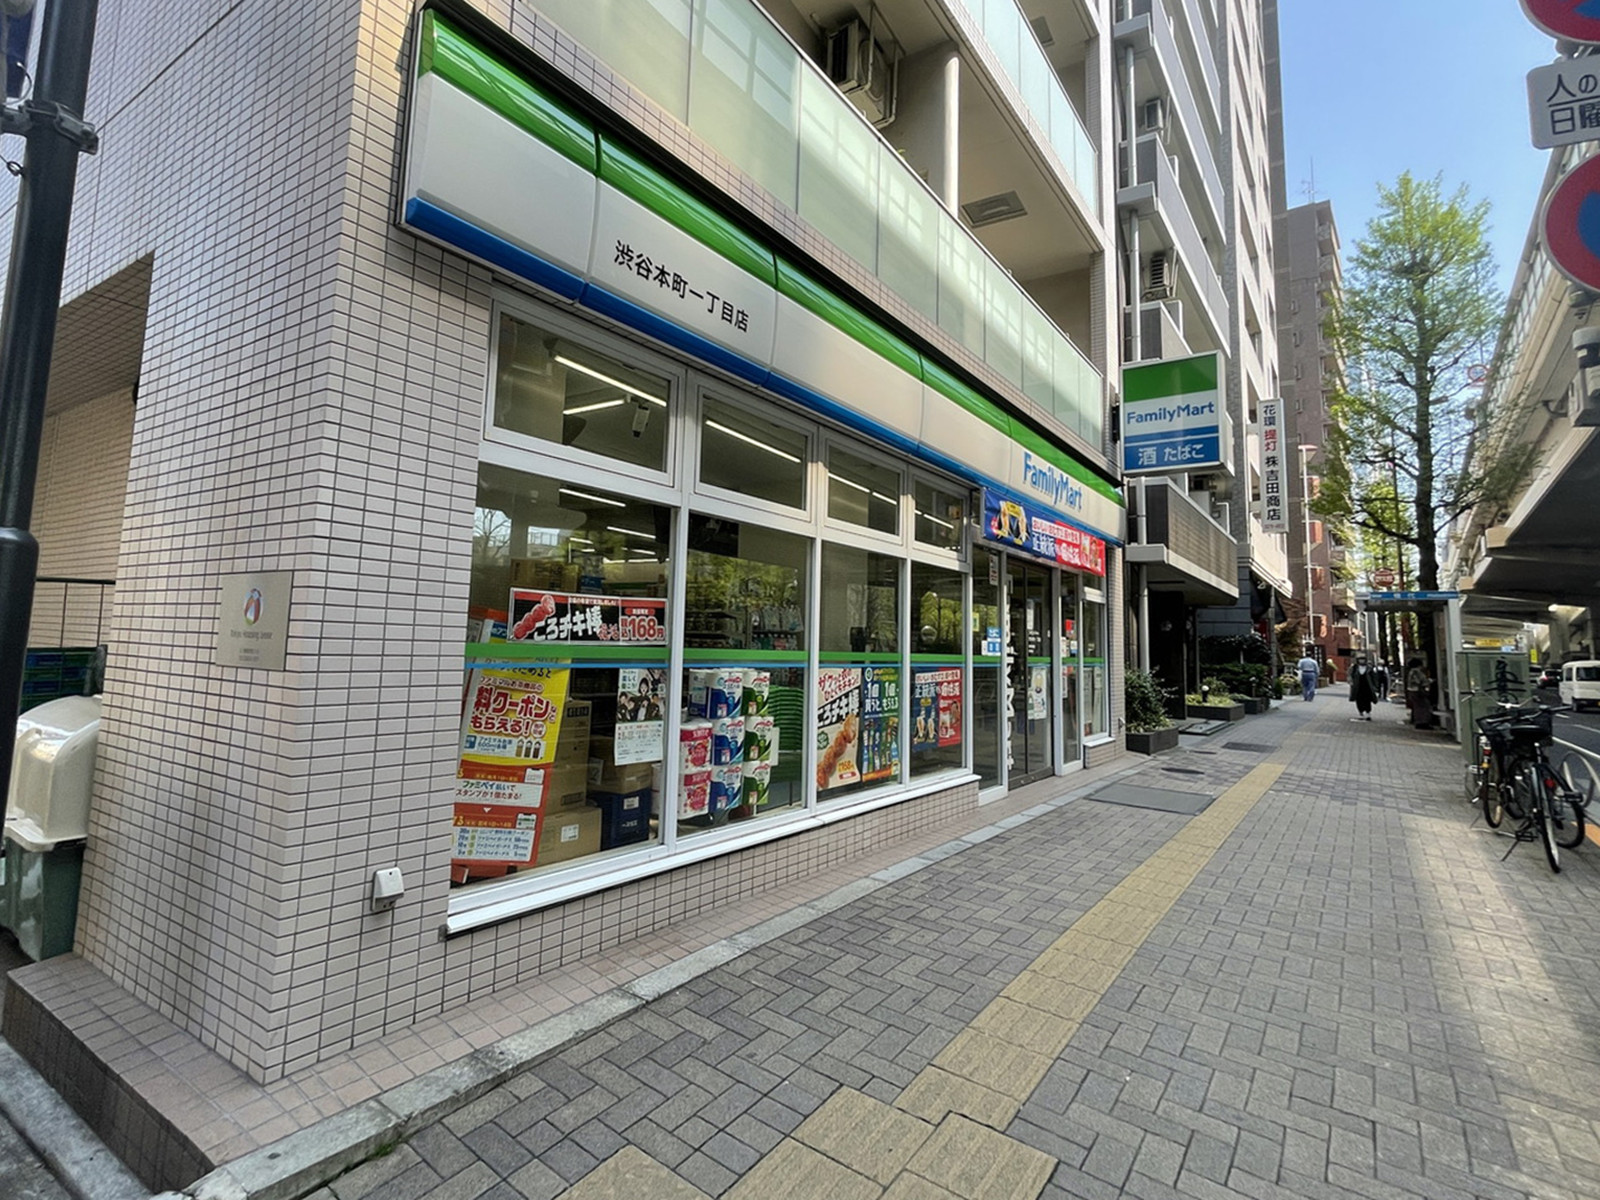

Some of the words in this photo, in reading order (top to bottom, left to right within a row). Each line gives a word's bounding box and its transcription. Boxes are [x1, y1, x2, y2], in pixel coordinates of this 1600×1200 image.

[1547, 73, 1598, 103] 人の
[614, 240, 749, 333] 渋谷本町一丁目店
[1127, 401, 1215, 425] FamilyMart
[1138, 446, 1157, 466] 酒
[1163, 443, 1205, 462] たばこ
[1023, 451, 1083, 511] FamilyMart
[534, 605, 602, 641] ころチキ棒
[470, 714, 531, 735] もらえる!
